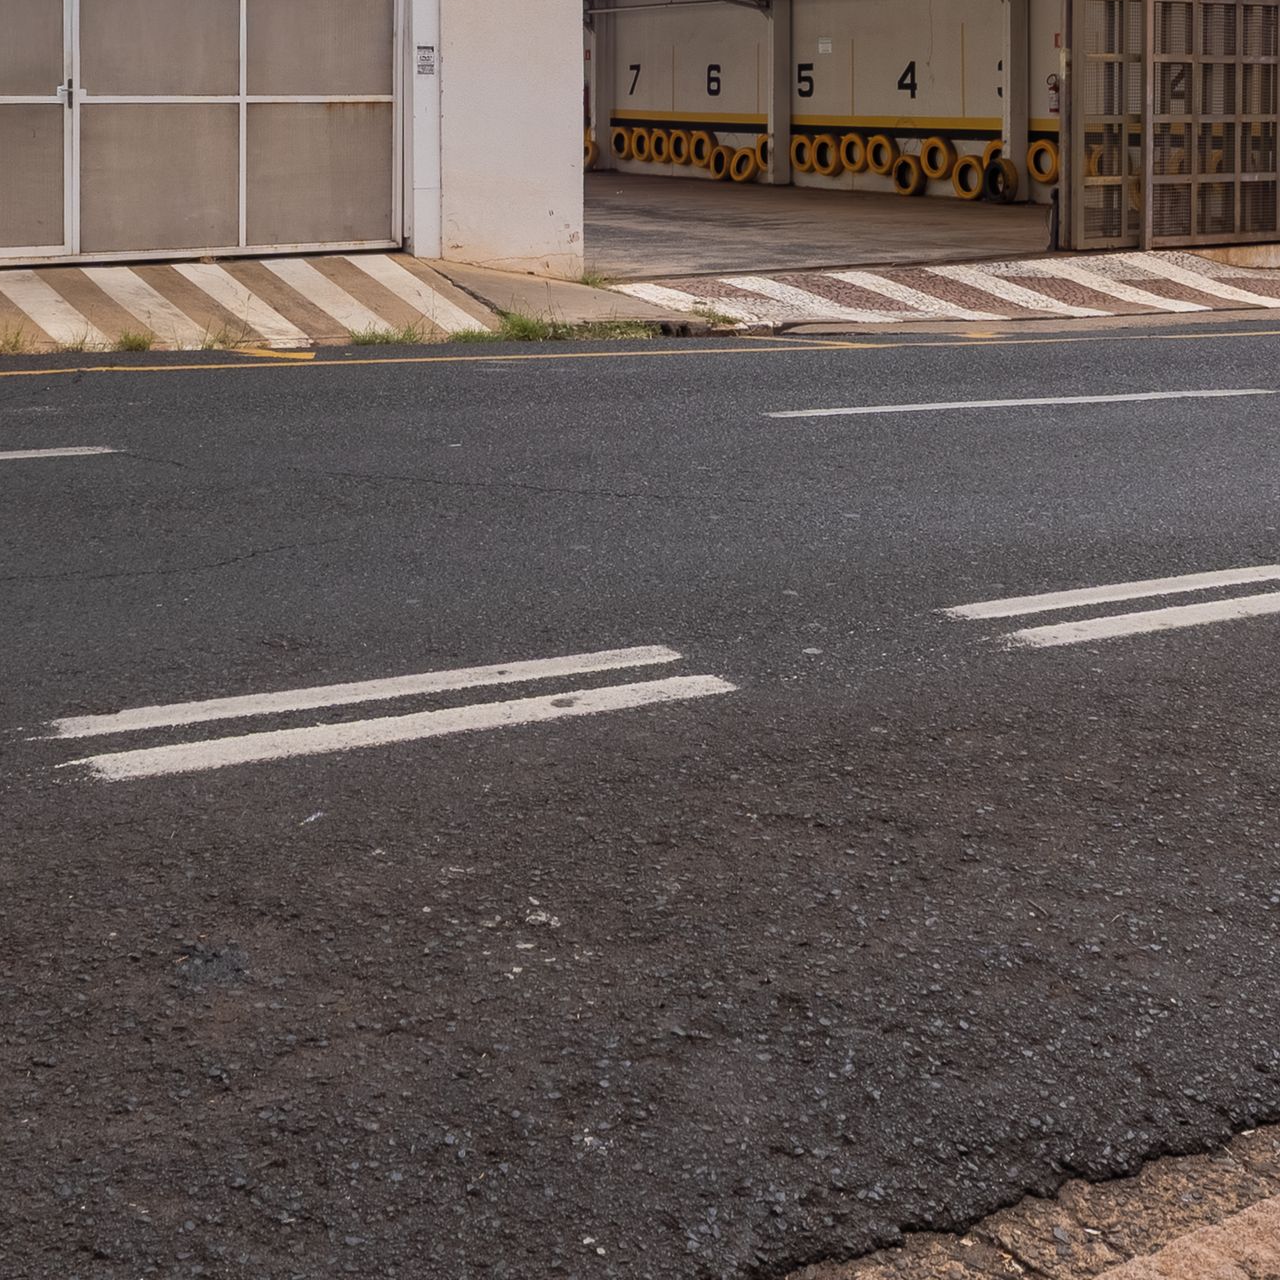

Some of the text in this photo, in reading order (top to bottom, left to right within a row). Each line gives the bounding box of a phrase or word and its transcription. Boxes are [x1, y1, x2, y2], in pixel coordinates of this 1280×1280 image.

[628, 63, 641, 96] 7
[706, 63, 721, 97] 6
[797, 63, 815, 98] 5
[897, 60, 918, 99] 4
